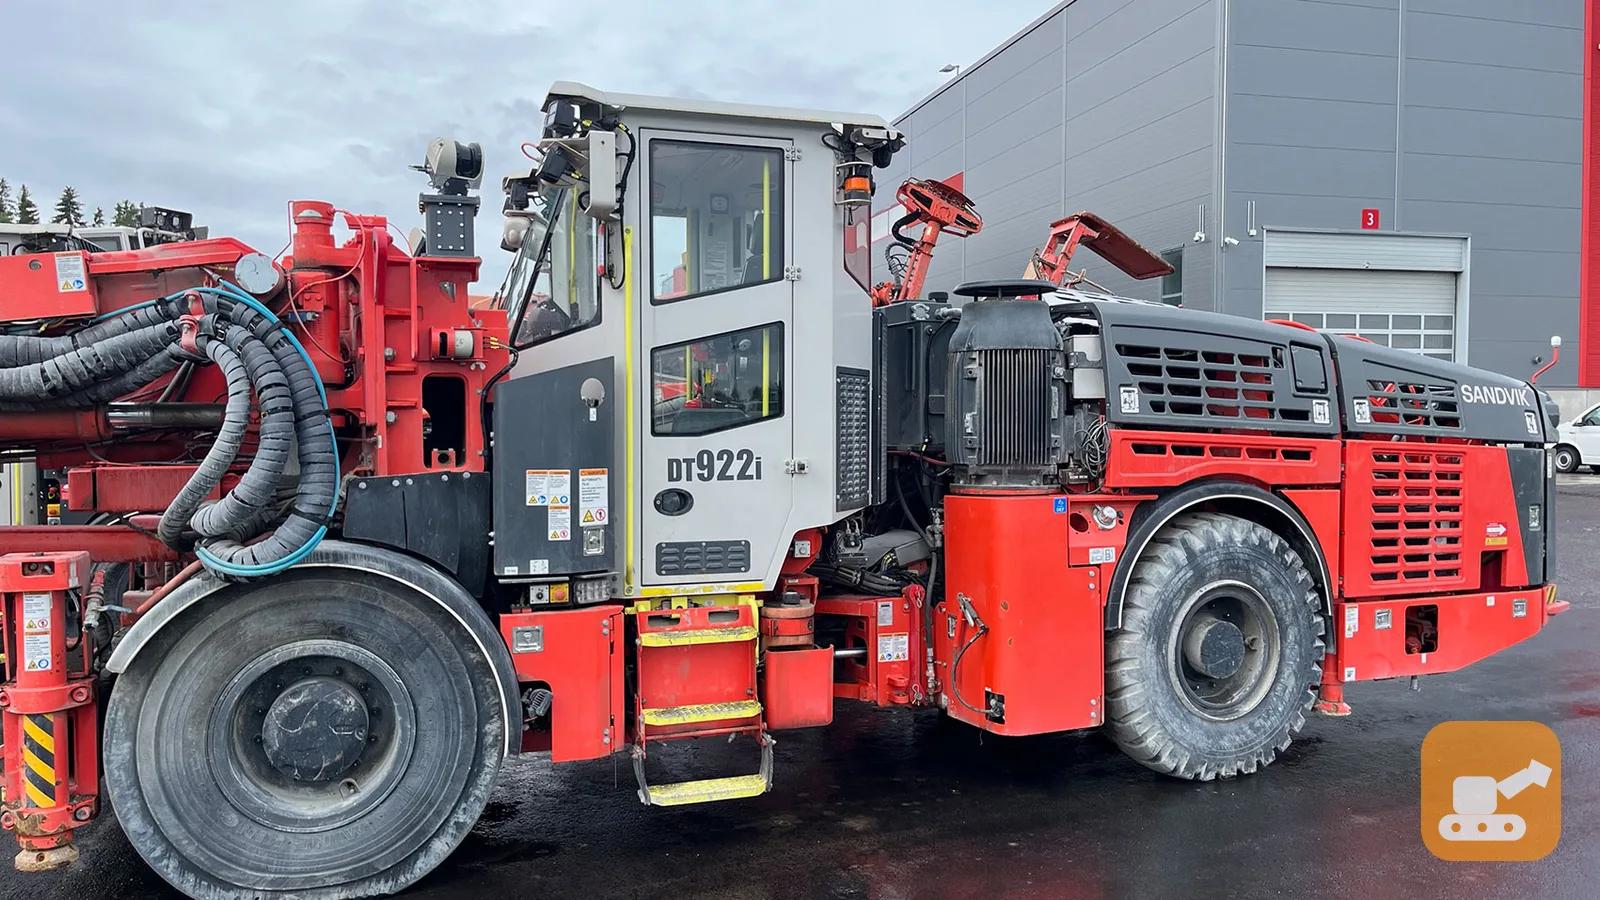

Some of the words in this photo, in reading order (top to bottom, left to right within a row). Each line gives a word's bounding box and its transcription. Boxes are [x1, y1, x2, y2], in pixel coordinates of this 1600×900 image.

[1367, 212, 1374, 226] 3
[1460, 384, 1530, 407] SANDVIK
[667, 448, 762, 482] DT922i
